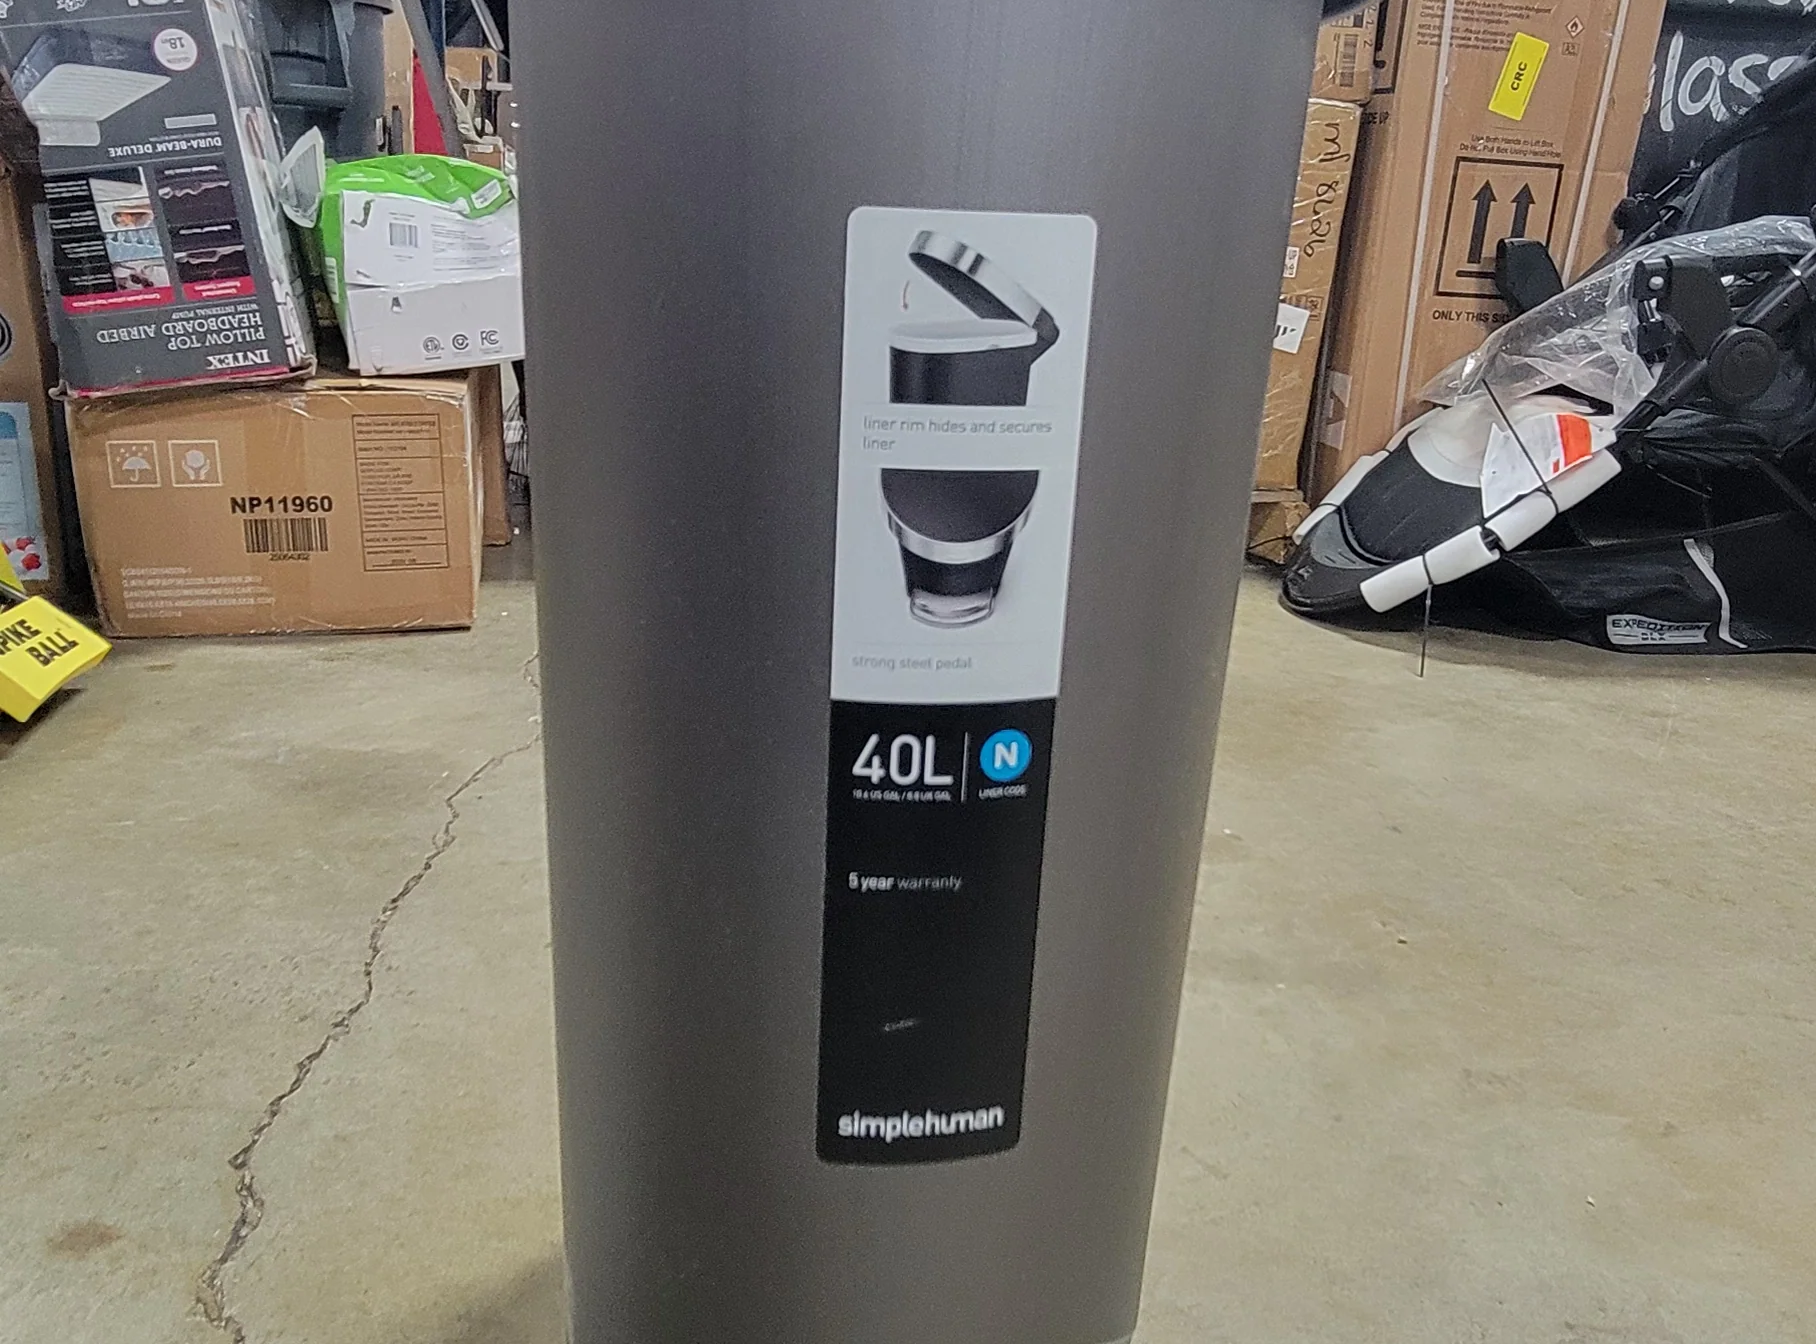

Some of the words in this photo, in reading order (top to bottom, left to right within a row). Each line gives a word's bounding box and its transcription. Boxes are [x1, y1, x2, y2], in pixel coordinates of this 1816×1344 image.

[1510, 61, 1528, 91] CRC
[107, 143, 152, 157] DELUXE
[235, 302, 257, 312] WITH
[1432, 309, 1462, 321] ONLY
[1464, 311, 1489, 323] THIS
[95, 322, 156, 343] AIRBED
[160, 311, 263, 336] HEADBOARD
[167, 332, 201, 349] TOP
[203, 326, 265, 346] PILLOW
[205, 348, 271, 370] INTEX
[863, 415, 898, 432] liner
[900, 419, 925, 433] rim
[928, 419, 967, 434] hides
[969, 420, 996, 434] and
[999, 421, 1053, 434] secures
[862, 435, 896, 451] liner
[230, 495, 334, 514] NP11960
[25, 630, 80, 667] BALL
[851, 656, 896, 672] strong
[899, 656, 932, 671] steel
[935, 657, 973, 671] pedal
[851, 733, 955, 787] 40L
[993, 740, 1020, 770] N
[860, 875, 895, 893] year
[896, 875, 963, 892] warranty
[837, 1105, 1006, 1144] simplehuman
